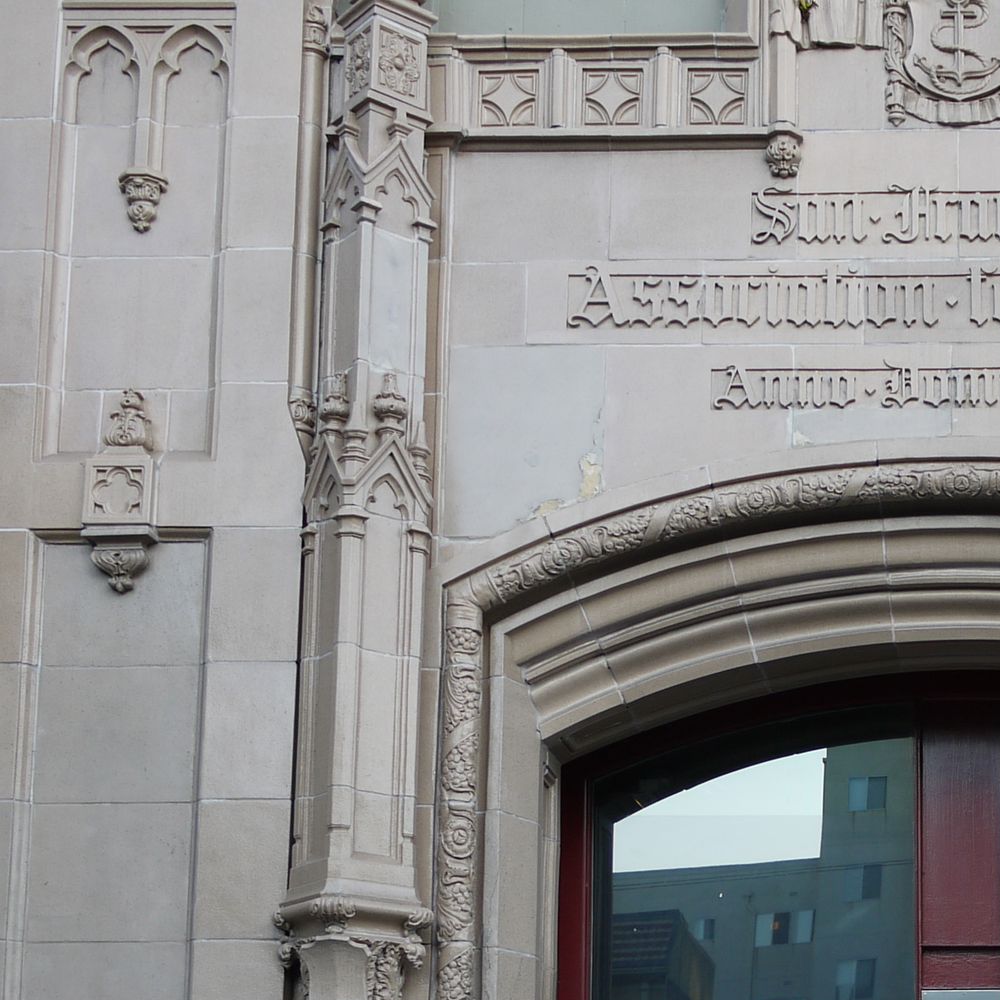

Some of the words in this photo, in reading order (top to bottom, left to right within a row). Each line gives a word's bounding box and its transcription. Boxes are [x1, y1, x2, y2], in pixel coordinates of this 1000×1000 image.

[752, 187, 867, 244] San
[567, 264, 939, 328] Association
[713, 365, 857, 409] Anno
